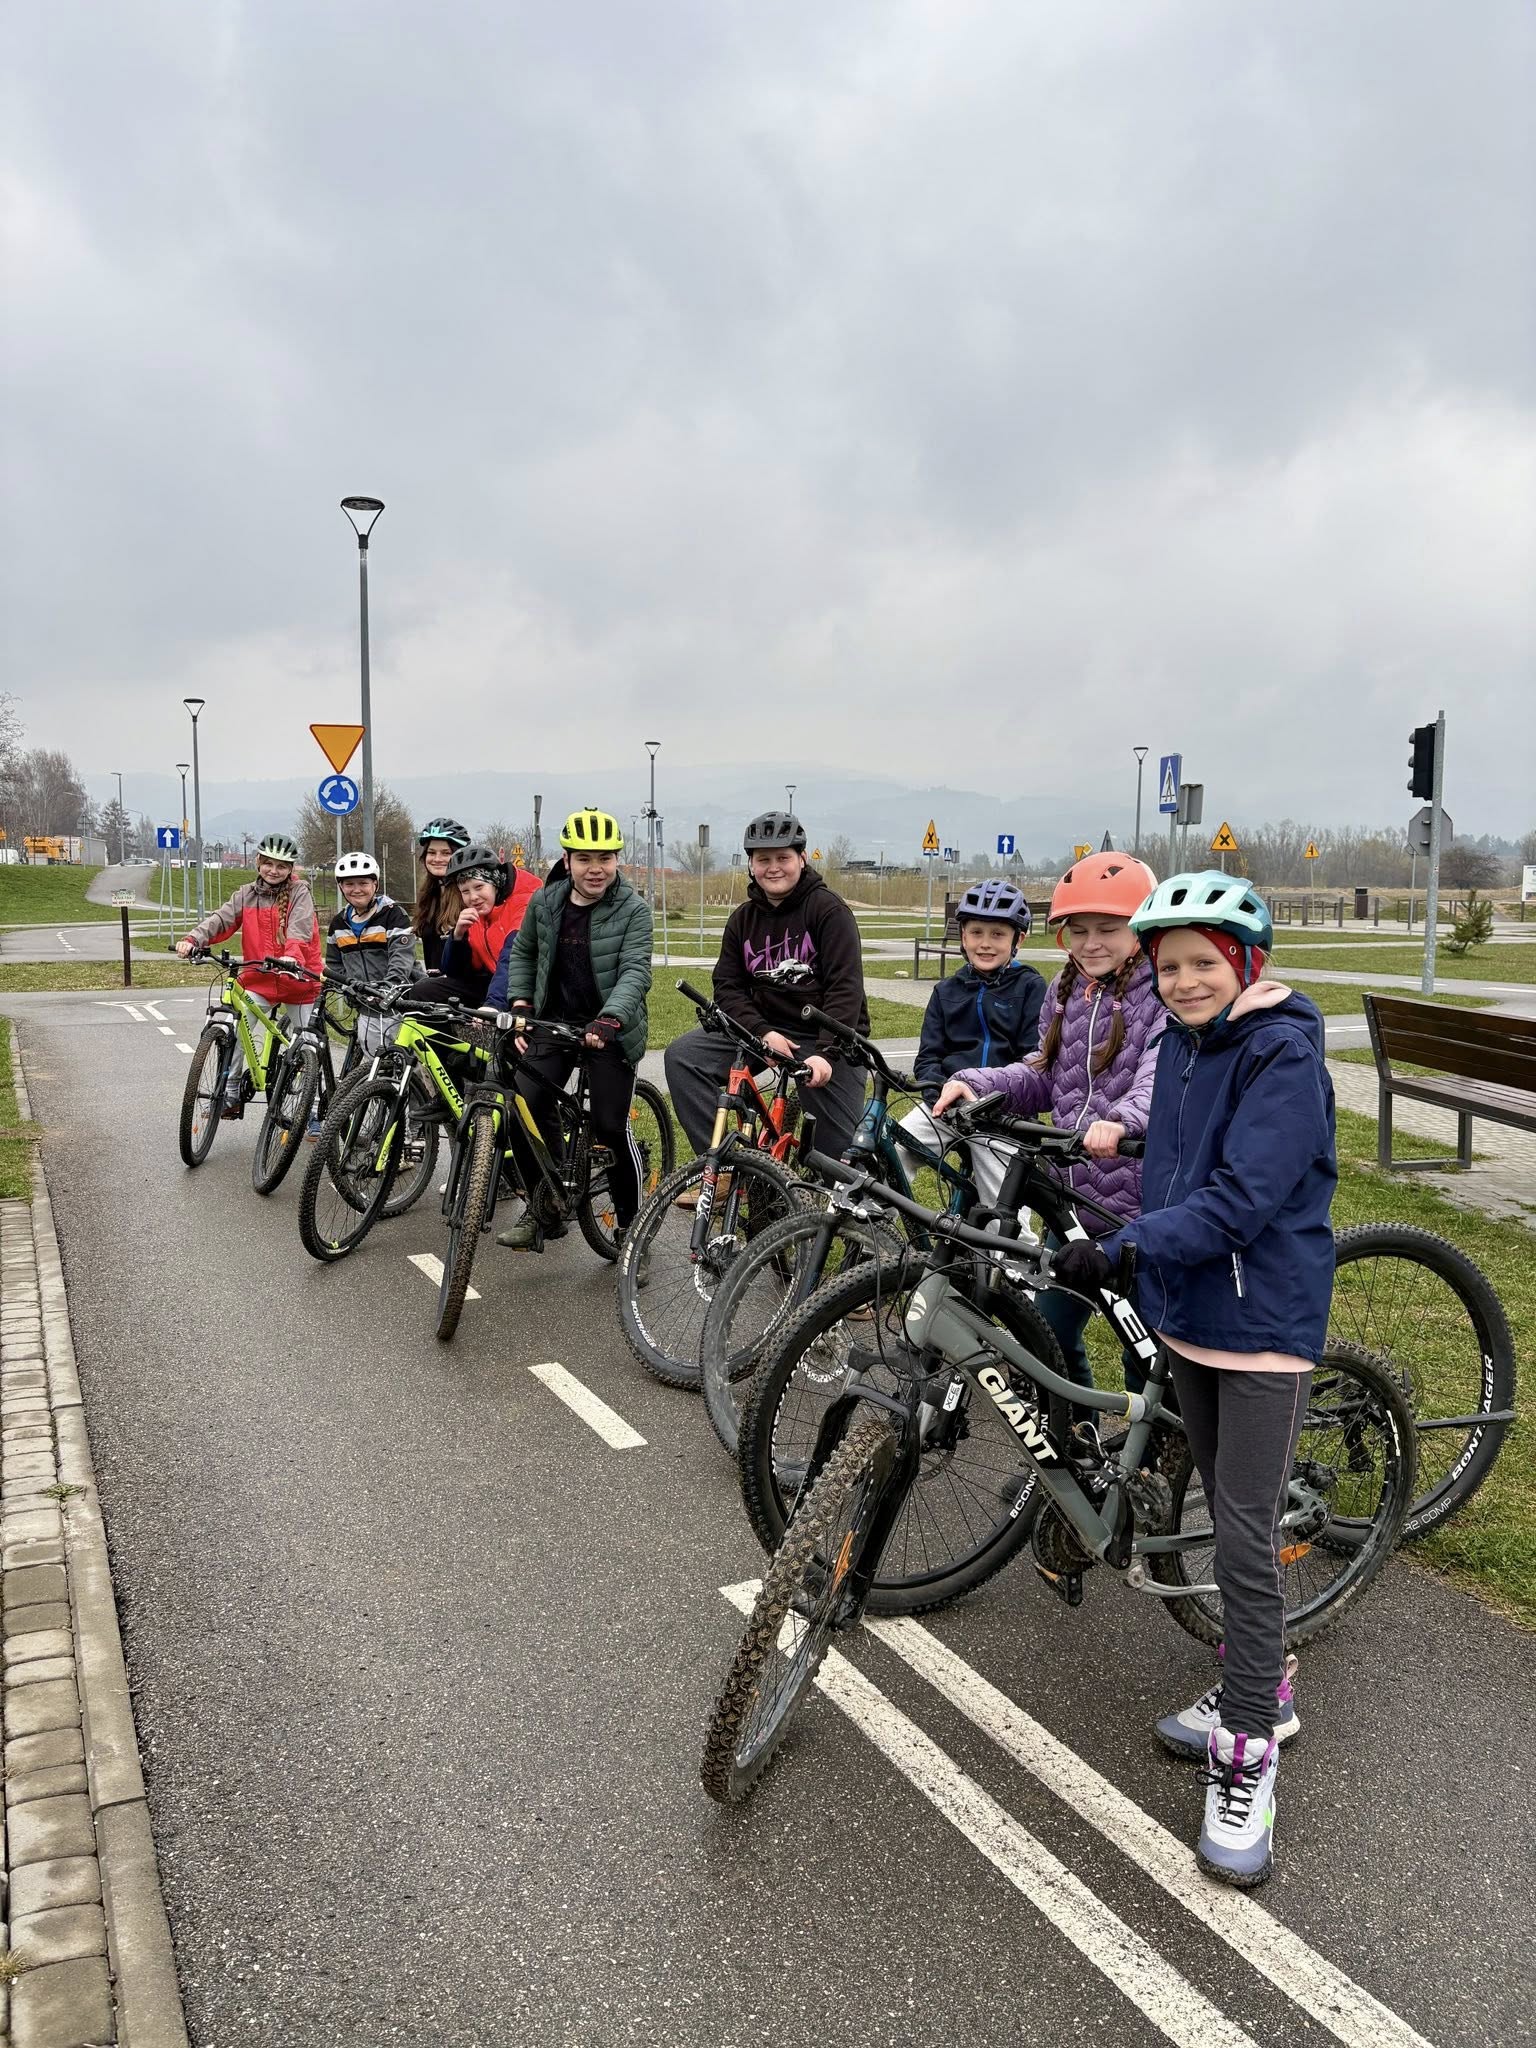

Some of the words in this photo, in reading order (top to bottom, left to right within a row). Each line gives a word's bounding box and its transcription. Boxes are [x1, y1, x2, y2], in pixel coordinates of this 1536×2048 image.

[696, 1181, 714, 1223] FOX
[749, 1229, 787, 1260] KENDA
[631, 1300, 657, 1348] BONTRAGER
[945, 1386, 957, 1409] XCE
[977, 1367, 1059, 1461] GIANT
[1452, 1354, 1494, 1482] BONTAGER
[1421, 1497, 1452, 1524] COMP
